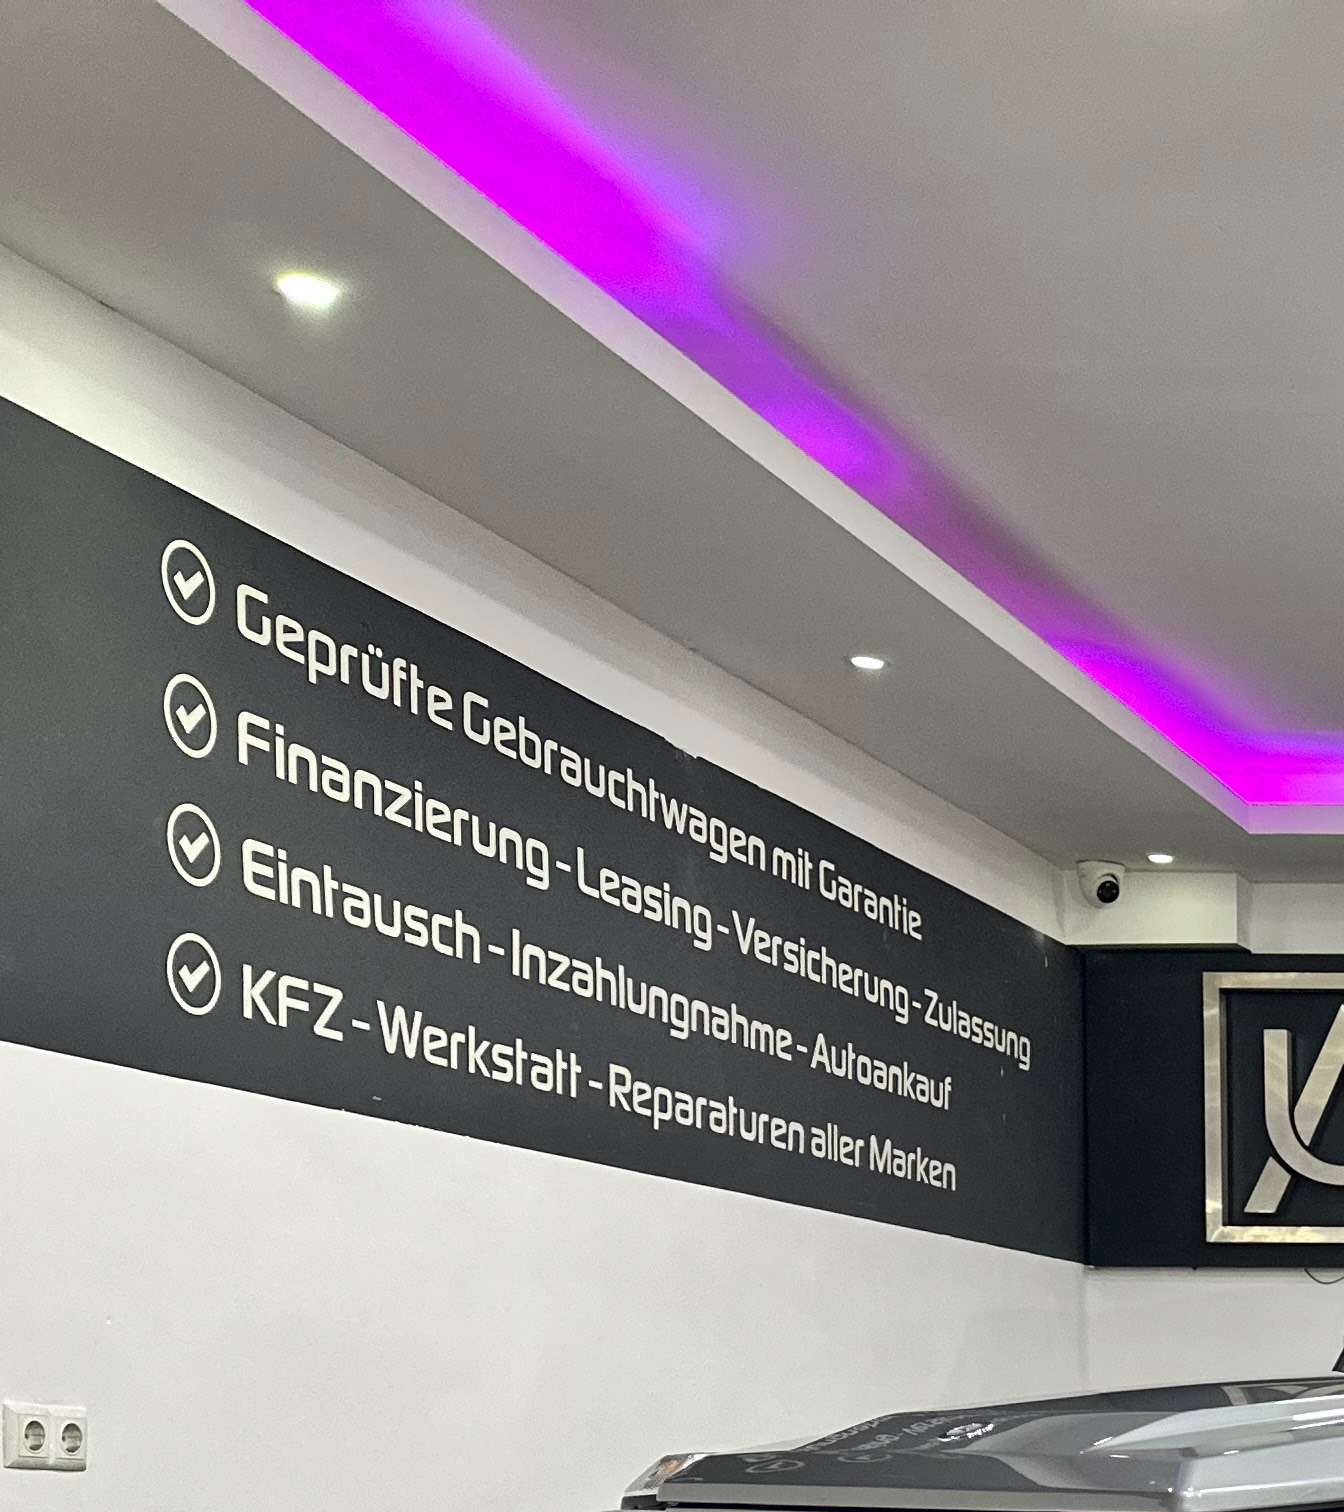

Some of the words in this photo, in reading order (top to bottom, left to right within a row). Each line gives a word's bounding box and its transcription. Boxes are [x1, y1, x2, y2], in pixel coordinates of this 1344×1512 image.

[237, 584, 453, 730] Geprüfte
[463, 691, 766, 871] Gebrauchtwagen
[772, 843, 813, 890] mit
[819, 860, 923, 940] Garantie
[811, 1123, 864, 1167] aller
[870, 1135, 957, 1191] Marken
